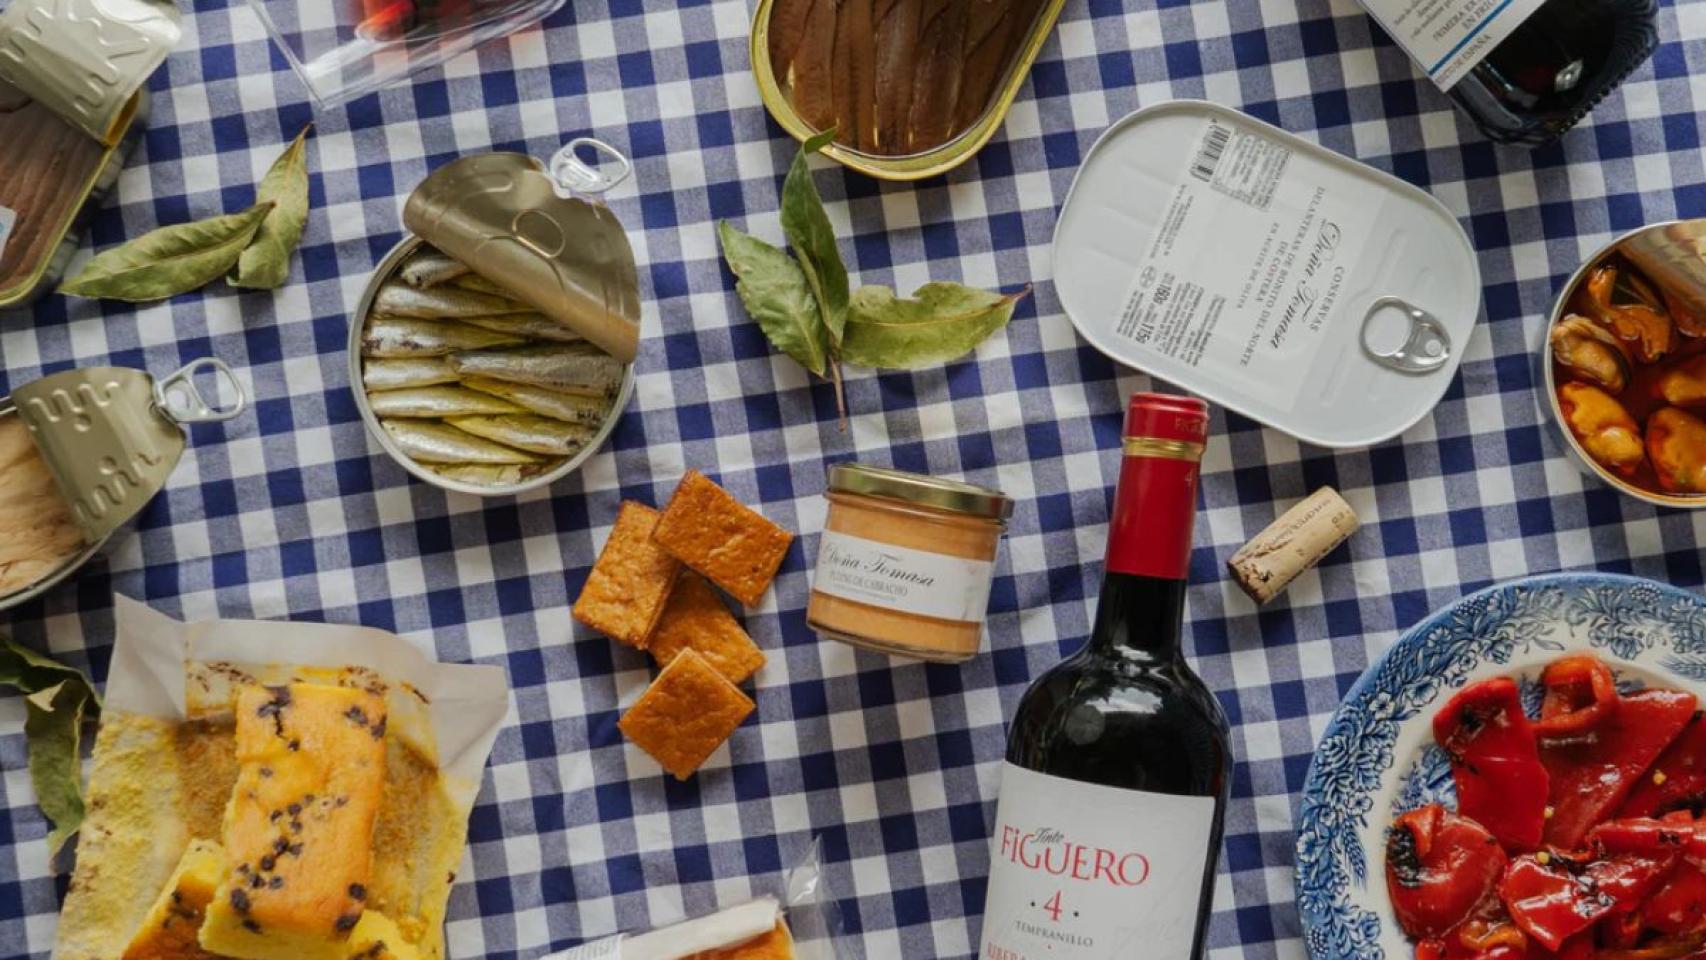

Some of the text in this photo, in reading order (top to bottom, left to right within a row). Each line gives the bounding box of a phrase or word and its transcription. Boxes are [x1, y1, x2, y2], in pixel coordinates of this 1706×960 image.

[1255, 241, 1288, 302] DE COSTERA
[1283, 253, 1296, 267] DE
[1266, 269, 1288, 308] BONITO
[1270, 218, 1341, 349] Doña Tomasa
[1309, 266, 1345, 332] CONSERVAS
[1256, 310, 1271, 329] DEL
[1240, 332, 1260, 367] NORTE
[864, 551, 934, 587] Tomasa
[1031, 826, 1065, 844] Tinto
[1043, 889, 1063, 922] 4
[1015, 919, 1094, 947] TEMPRANILLO
